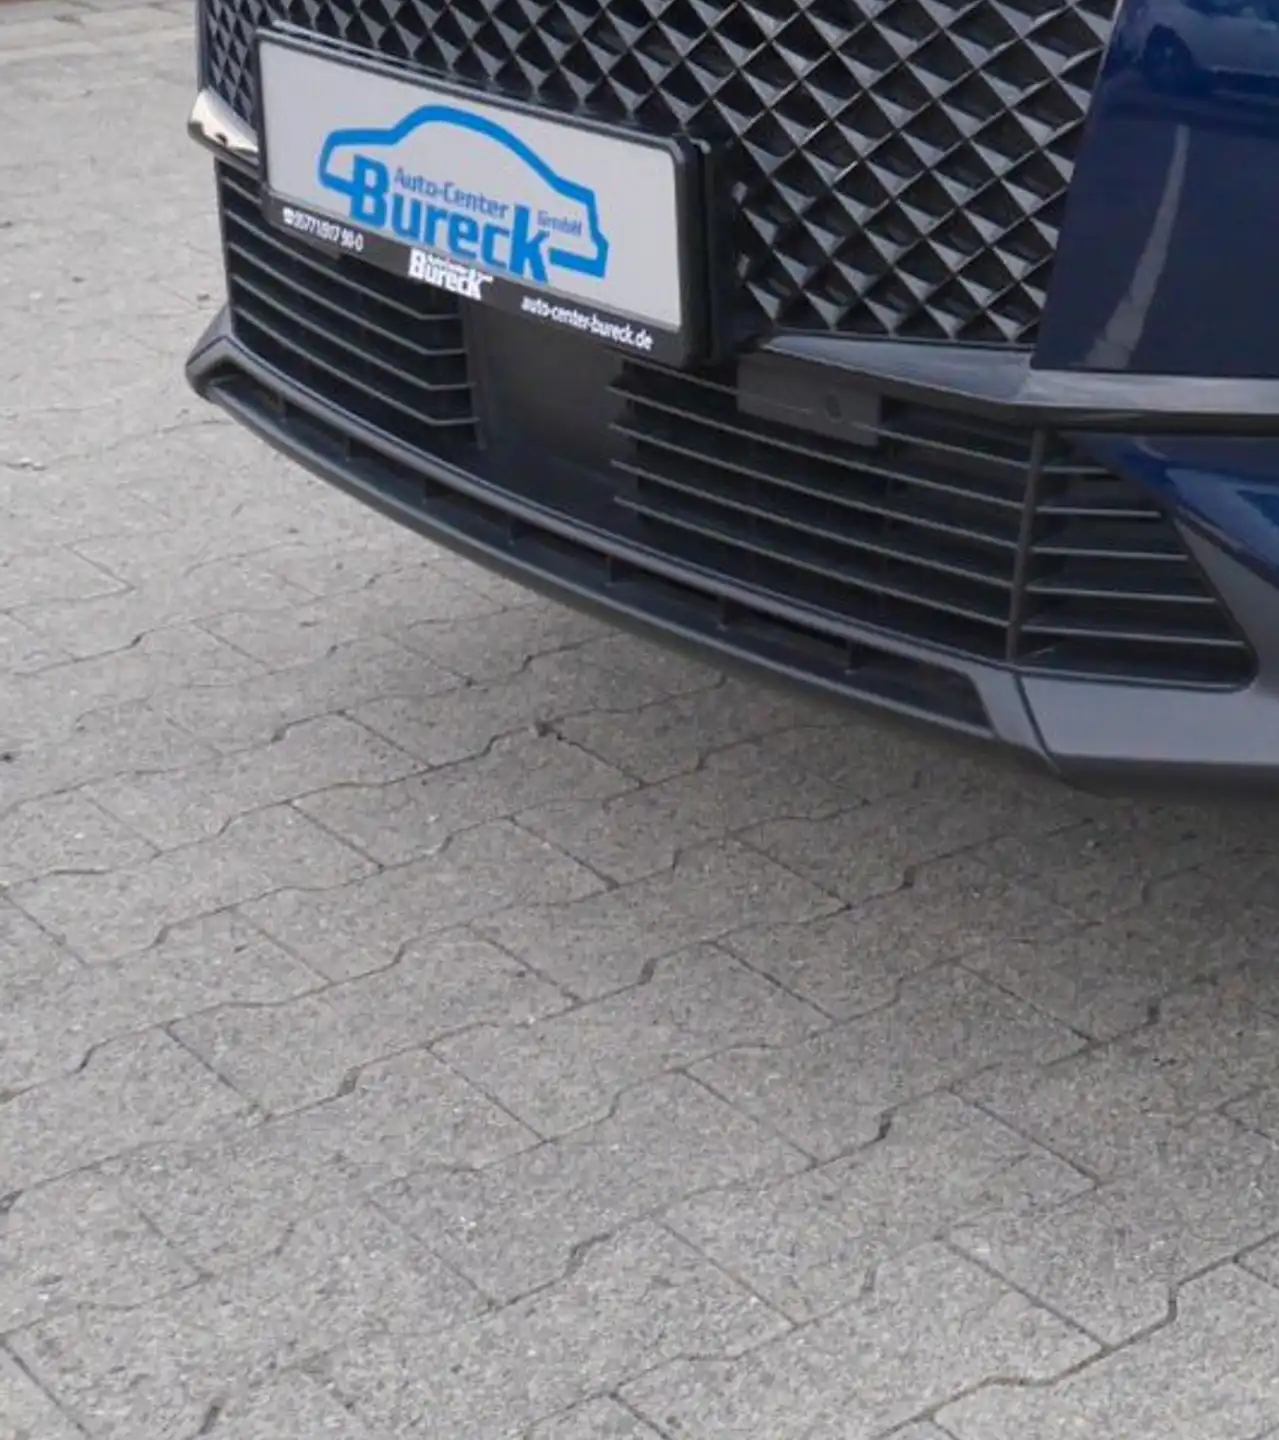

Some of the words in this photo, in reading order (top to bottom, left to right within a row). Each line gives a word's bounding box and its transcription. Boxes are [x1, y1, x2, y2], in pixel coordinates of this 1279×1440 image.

[350, 154, 548, 283] Bureck
[393, 166, 509, 220] Auto-Center
[536, 209, 583, 237] GmbH
[407, 247, 482, 300] Bureck
[520, 295, 654, 351] auto-center-bureck.de
